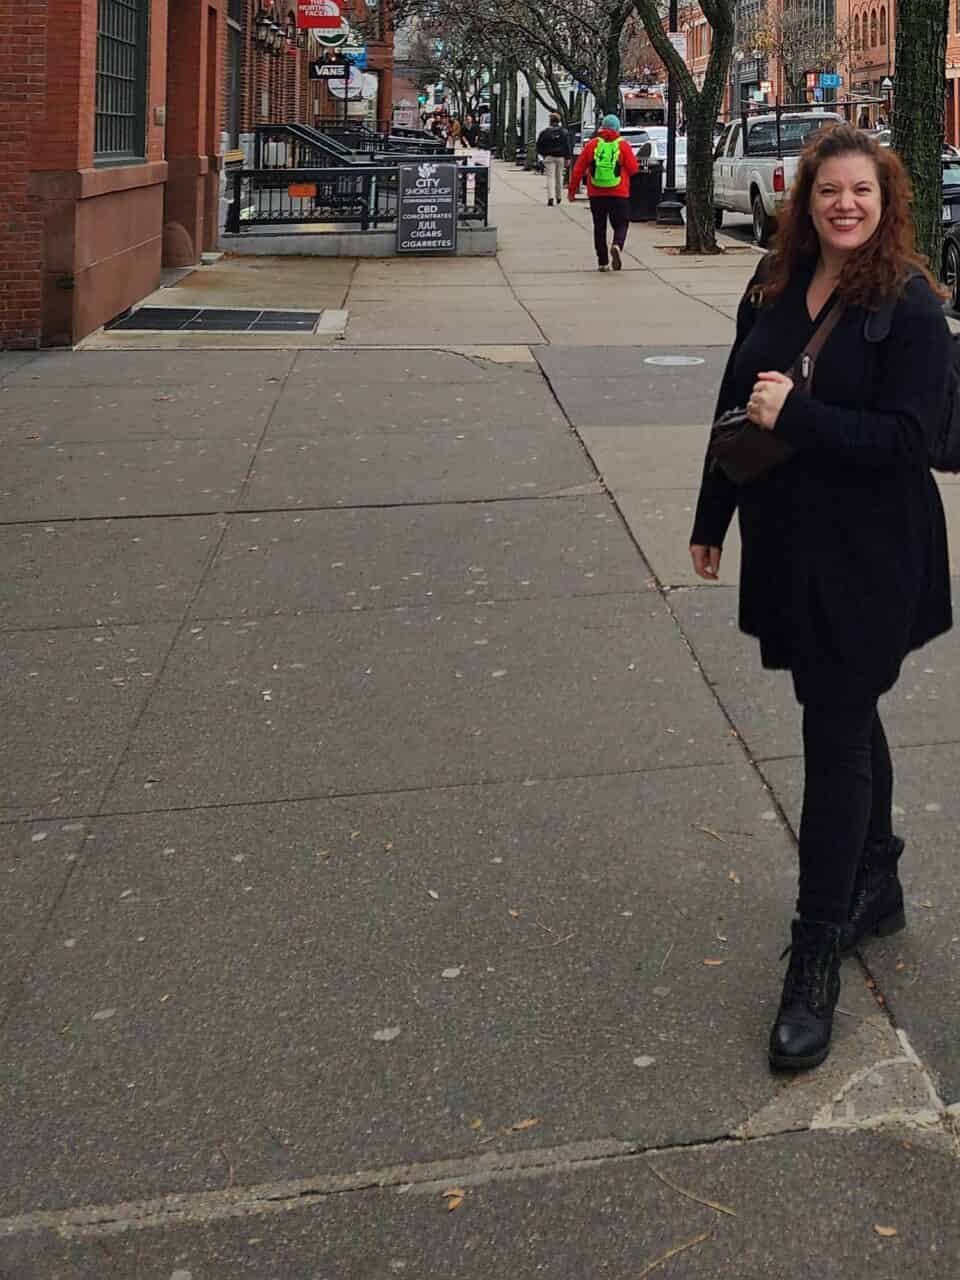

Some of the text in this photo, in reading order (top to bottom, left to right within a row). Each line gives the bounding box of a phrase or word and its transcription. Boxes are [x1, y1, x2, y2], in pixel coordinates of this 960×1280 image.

[314, 64, 345, 76] VANS
[415, 178, 440, 188] CITY
[410, 230, 442, 239] CIGARS
